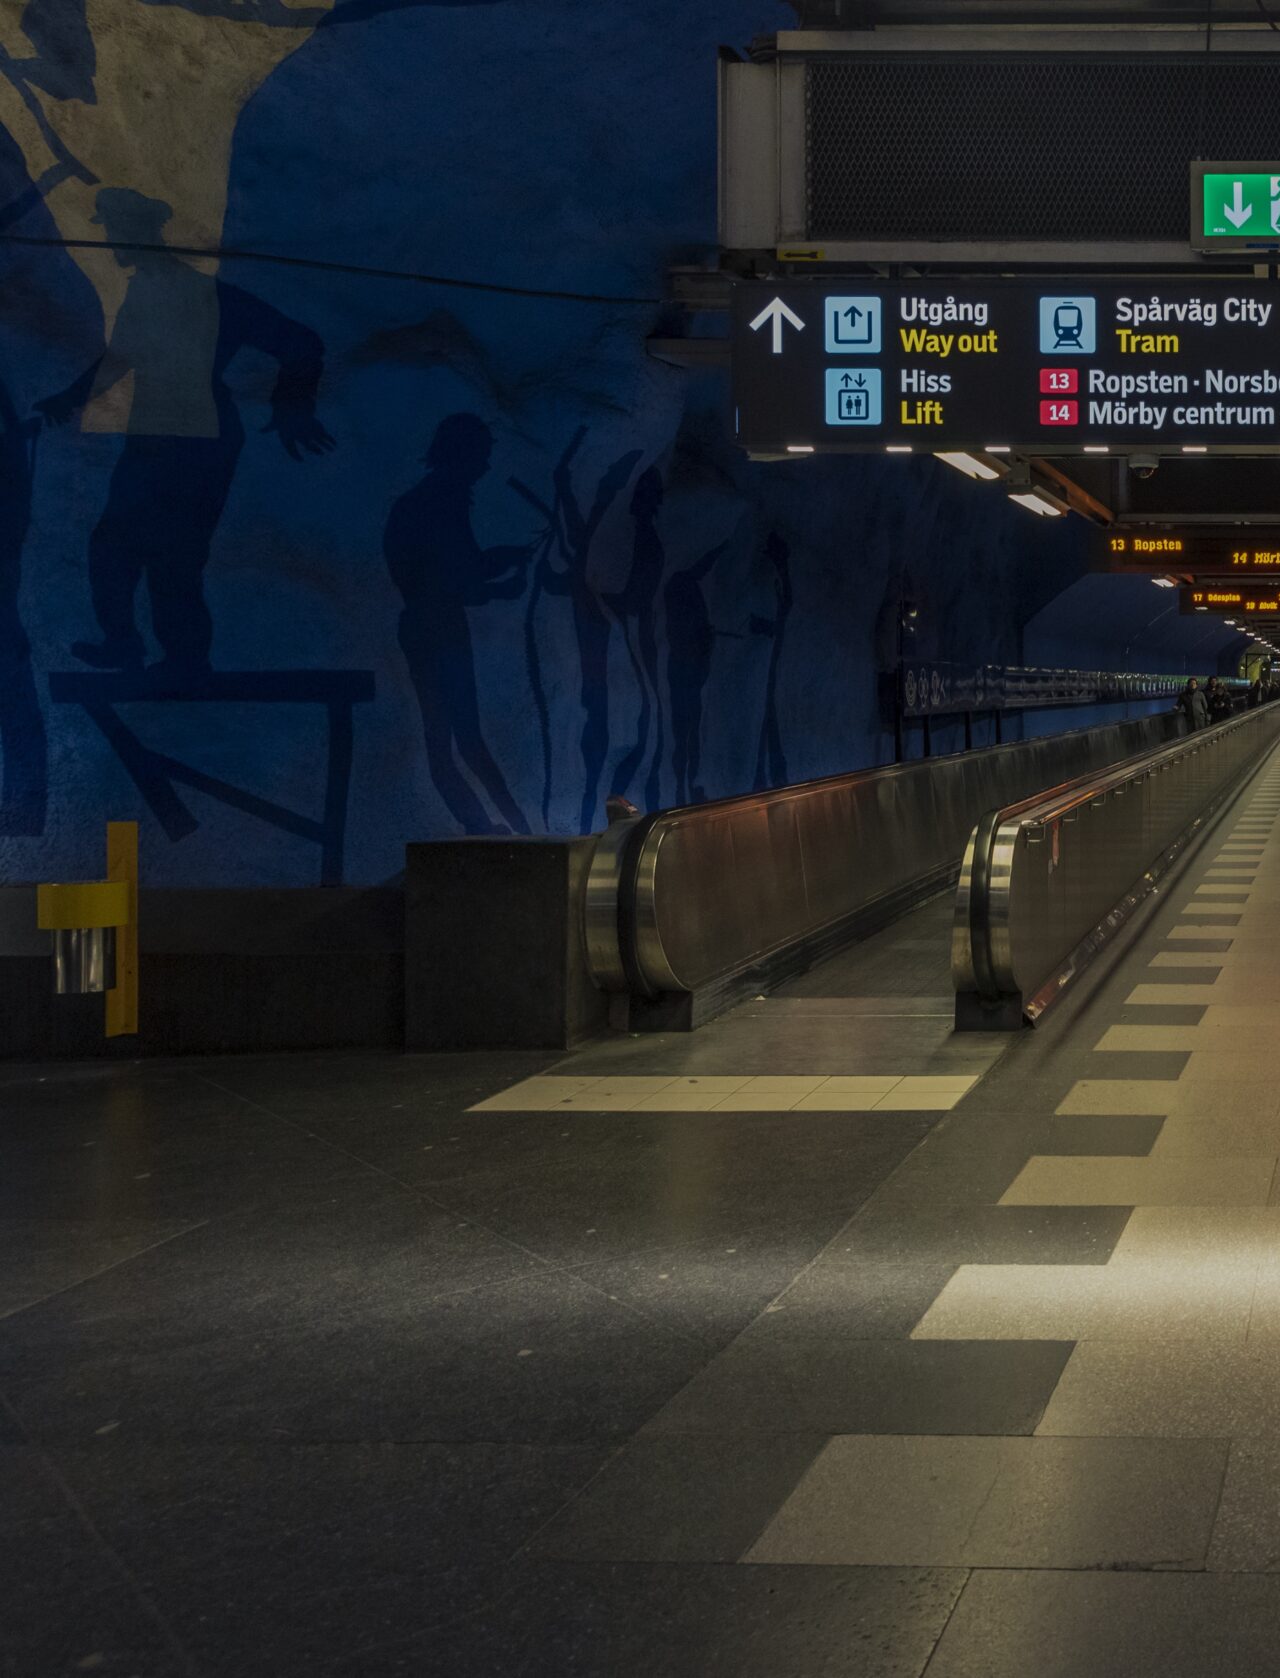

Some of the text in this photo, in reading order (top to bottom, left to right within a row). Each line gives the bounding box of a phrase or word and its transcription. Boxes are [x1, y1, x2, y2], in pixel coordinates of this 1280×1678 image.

[901, 296, 988, 326] Utgång
[1116, 296, 1273, 327] Spårväg City
[900, 329, 998, 358] Way out
[1116, 329, 1179, 353] Tram
[901, 369, 952, 393] Hiss
[1049, 372, 1070, 390] 13
[1089, 369, 1188, 399] Ropsten
[901, 400, 944, 425] Lift
[1049, 404, 1070, 421] 14
[1089, 401, 1168, 430] Mörby
[1173, 402, 1275, 425] centrum
[1111, 539, 1182, 553] 13 Ropsten
[1233, 553, 1248, 564] 14
[1193, 593, 1203, 602] 17
